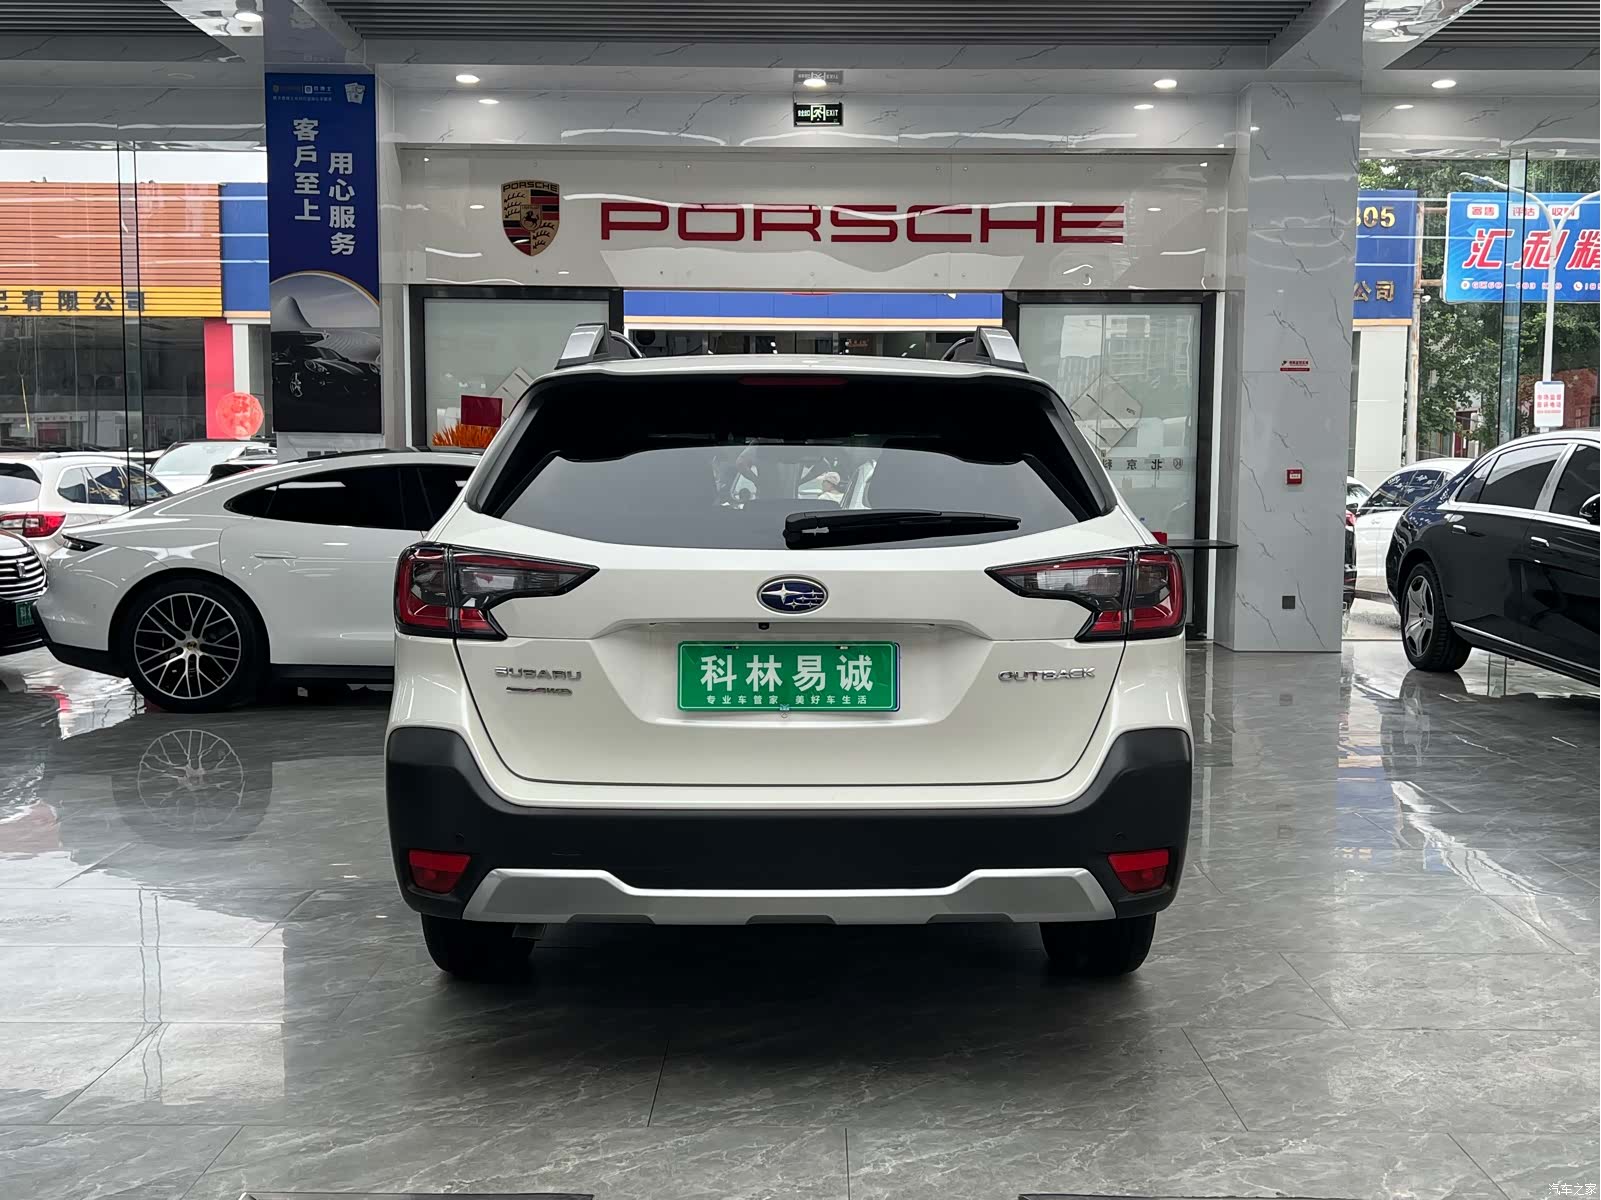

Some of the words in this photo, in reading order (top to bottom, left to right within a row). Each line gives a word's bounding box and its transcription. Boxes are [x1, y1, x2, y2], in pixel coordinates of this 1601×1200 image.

[502, 181, 559, 193] PORSCHE
[328, 152, 356, 255] 用心服务
[1512, 207, 1535, 217] 评估
[601, 202, 1125, 244] PORSCHE
[1353, 280, 1395, 302] 公司
[495, 666, 582, 681] SUBARU
[700, 654, 874, 692] 科林易诚
[998, 667, 1096, 681] OUTBACK
[706, 695, 778, 705] 专业车管家
[795, 695, 867, 705] 美好车生活
